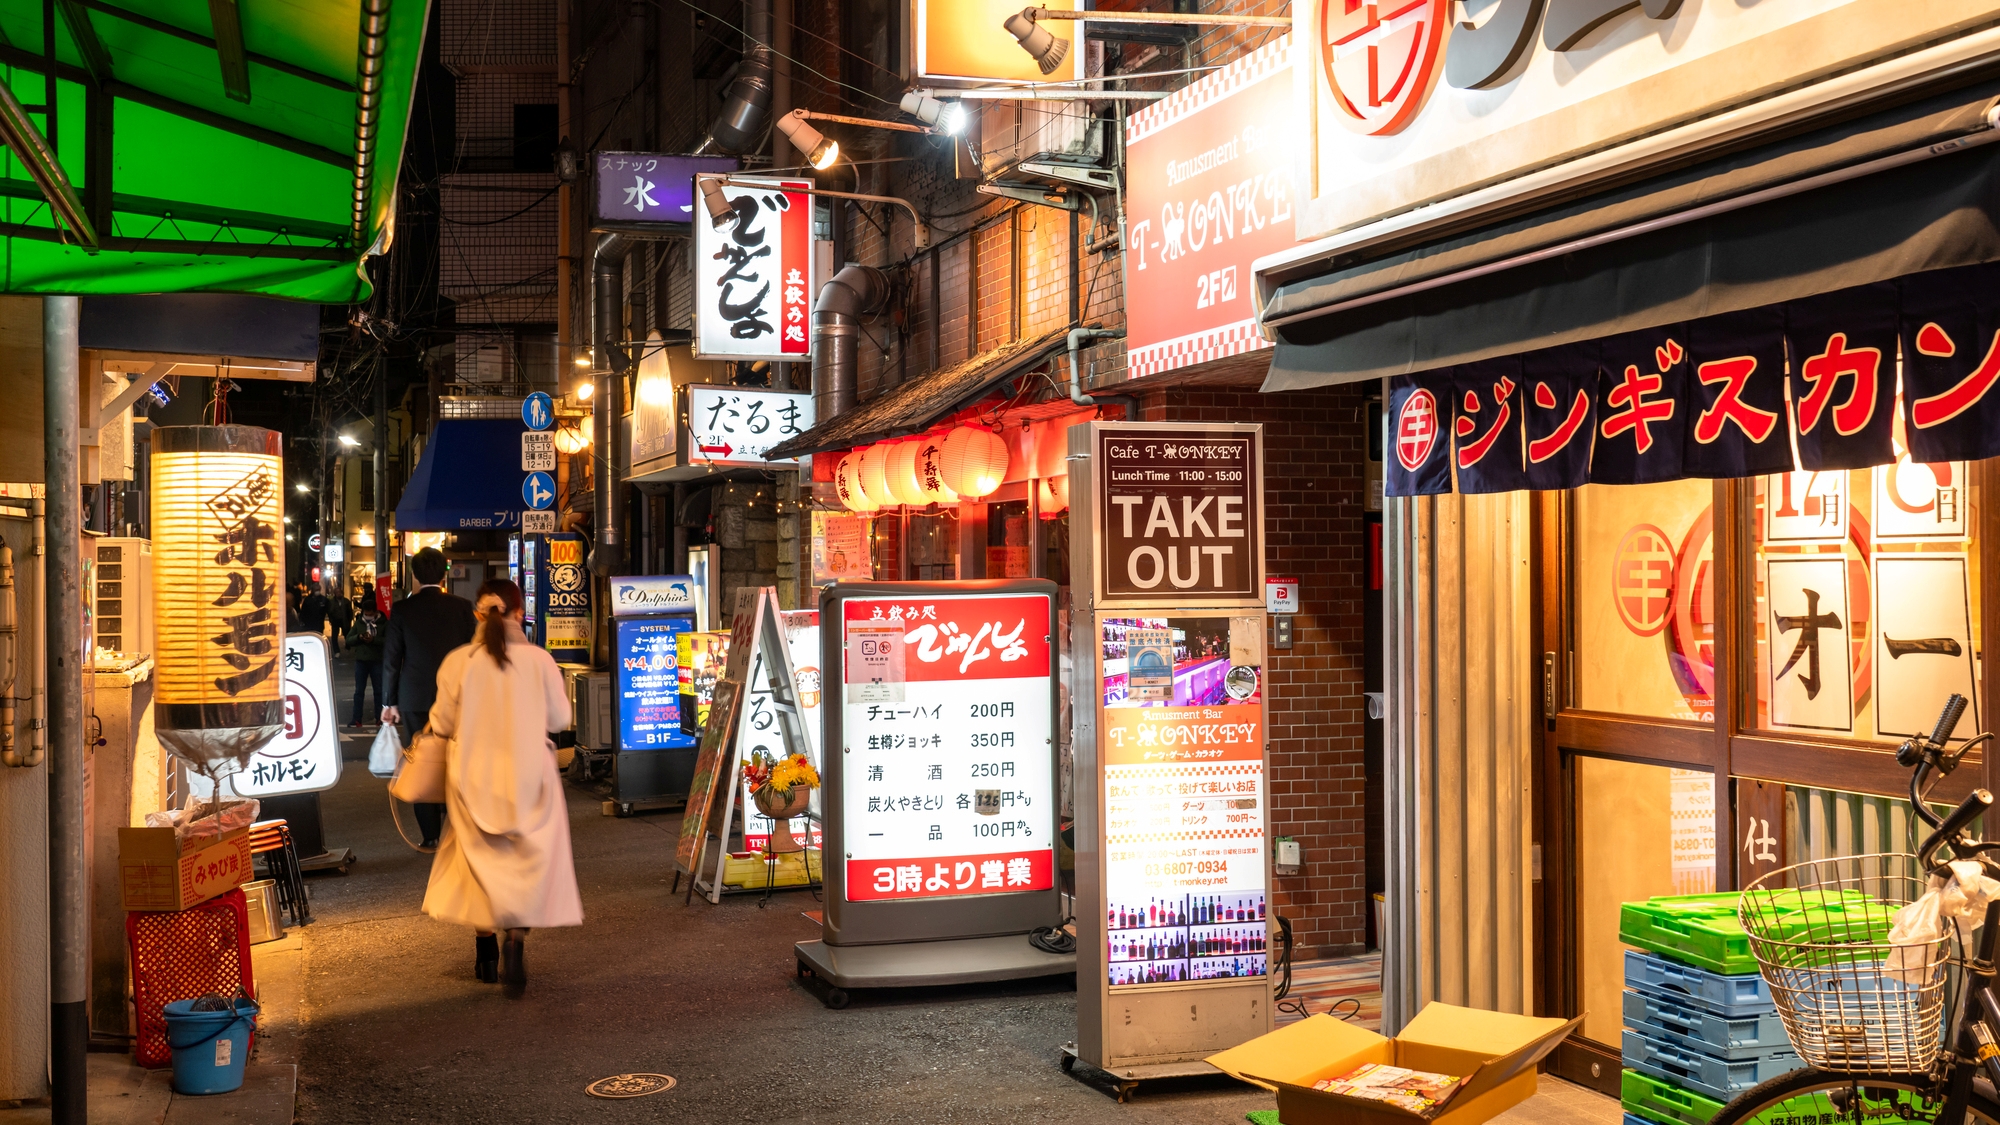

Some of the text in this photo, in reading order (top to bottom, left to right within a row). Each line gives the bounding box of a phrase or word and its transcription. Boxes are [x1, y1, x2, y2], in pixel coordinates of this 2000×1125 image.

[601, 158, 658, 172] スナック
[1168, 134, 1239, 187] Amusment
[1197, 267, 1220, 309] 2F
[785, 268, 806, 342] 立飲み処
[1456, 320, 2000, 470] ジンギスカン
[707, 396, 803, 434] だるま
[527, 443, 551, 451] 15-19
[709, 435, 724, 445] 2F
[1110, 445, 1139, 459] Cafe
[1112, 470, 1143, 481] Lunch
[1145, 470, 1170, 481] Time
[1179, 471, 1204, 481] 11:00
[1215, 471, 1242, 481] 15:00
[459, 518, 491, 527] BARBER
[1112, 496, 1244, 538] TAKE
[525, 522, 552, 530] 一方通行
[1127, 545, 1233, 589] OUT
[211, 515, 277, 696] ホルモン
[549, 593, 587, 606] BOSS
[629, 590, 683, 606] Dolphin
[868, 604, 937, 621] 立飲み処
[636, 636, 675, 644] オールタイム
[867, 702, 1014, 721] チューハイ 200円
[1142, 709, 1223, 721] Amusment Bar
[646, 733, 671, 743] B1F
[868, 731, 1014, 750] 生樽ジョッキ 350円
[252, 759, 316, 786] ホルモン
[971, 761, 1015, 777] 250円
[868, 795, 944, 813] 炭火やきとり
[1182, 801, 1205, 811] ダーツ
[1182, 815, 1207, 825] ドリンク
[194, 853, 239, 885] みやび炭
[873, 858, 1031, 892] 3時より営業
[1145, 860, 1227, 876] 03-6807-0934
